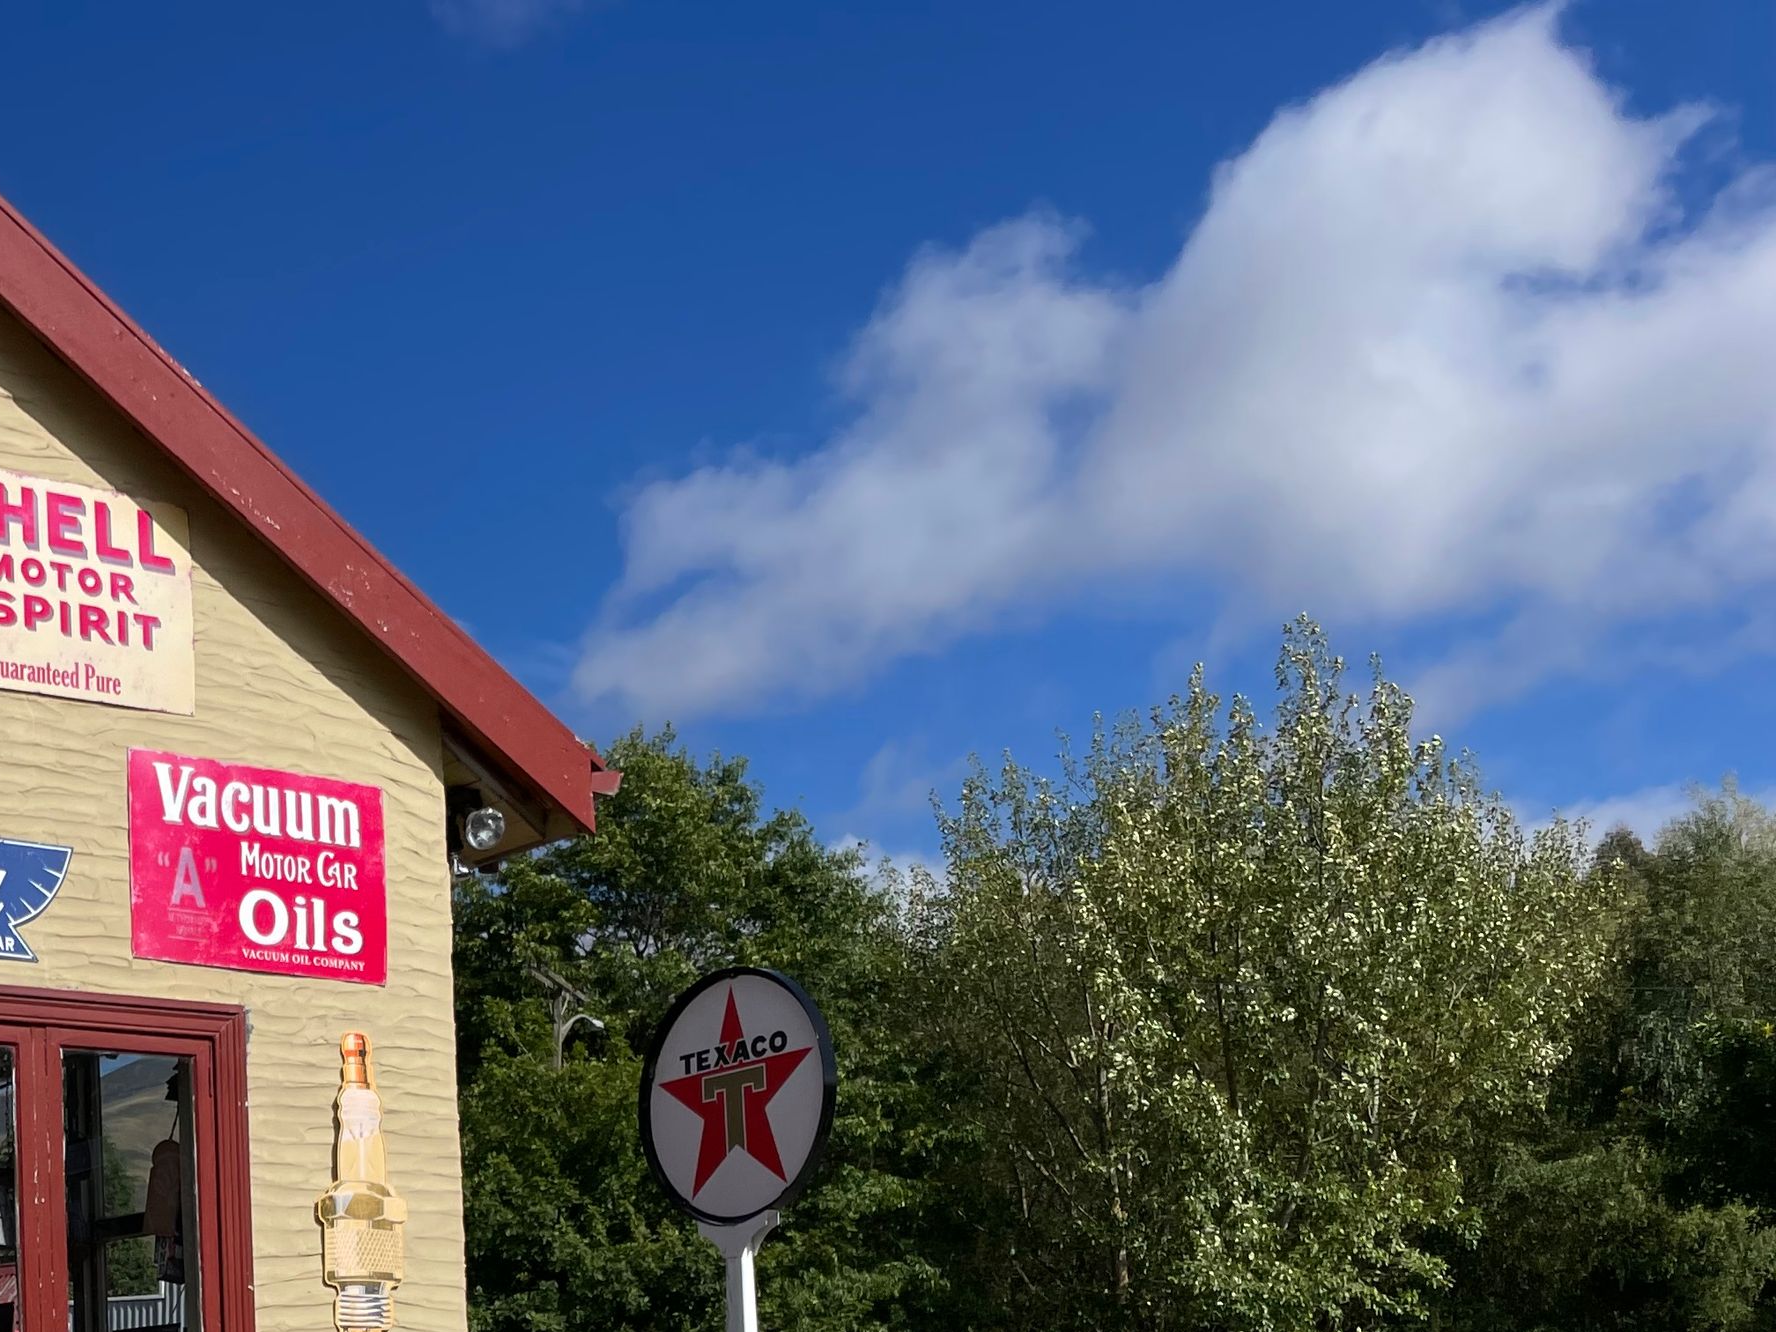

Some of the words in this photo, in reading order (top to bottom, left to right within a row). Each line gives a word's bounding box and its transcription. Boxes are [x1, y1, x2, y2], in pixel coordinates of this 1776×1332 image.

[84, 663, 122, 695] Pure
[152, 762, 361, 848] Vacuum
[238, 888, 363, 956] Oils
[242, 948, 289, 963] VACUUM
[292, 954, 311, 966] OIL
[313, 957, 365, 972] COMPANY
[679, 1030, 787, 1075] TEXACO
[702, 1063, 767, 1153] T
